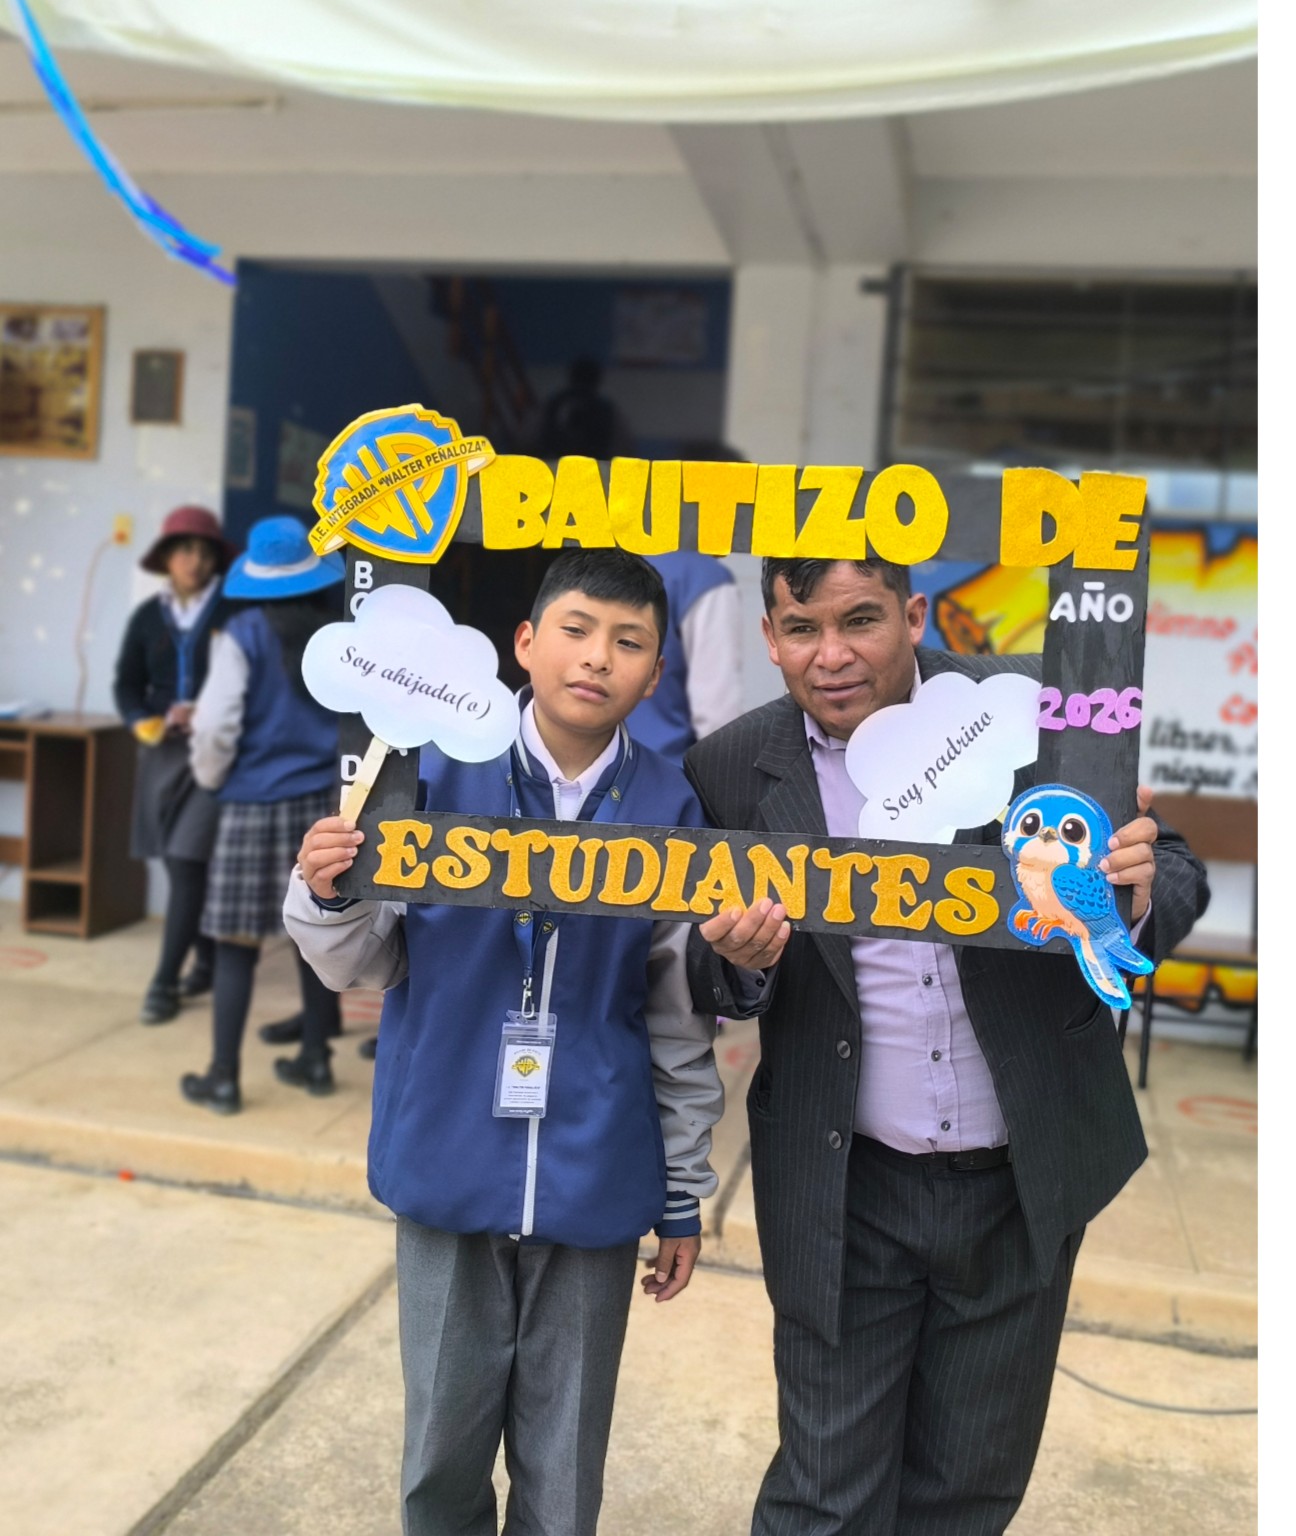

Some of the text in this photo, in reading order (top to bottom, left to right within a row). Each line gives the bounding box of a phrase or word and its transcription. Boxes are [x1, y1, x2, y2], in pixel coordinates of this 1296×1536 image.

[311, 523, 329, 543] I.E.
[325, 484, 380, 528] INTEGRADA
[478, 454, 1148, 571] BAUTIZO DE
[1049, 581, 1134, 623] AÑO
[340, 645, 377, 677] Soy
[1036, 686, 1143, 734] 2026
[882, 710, 994, 821] Soy padrino
[373, 819, 1000, 936] ESTUDIANTES
